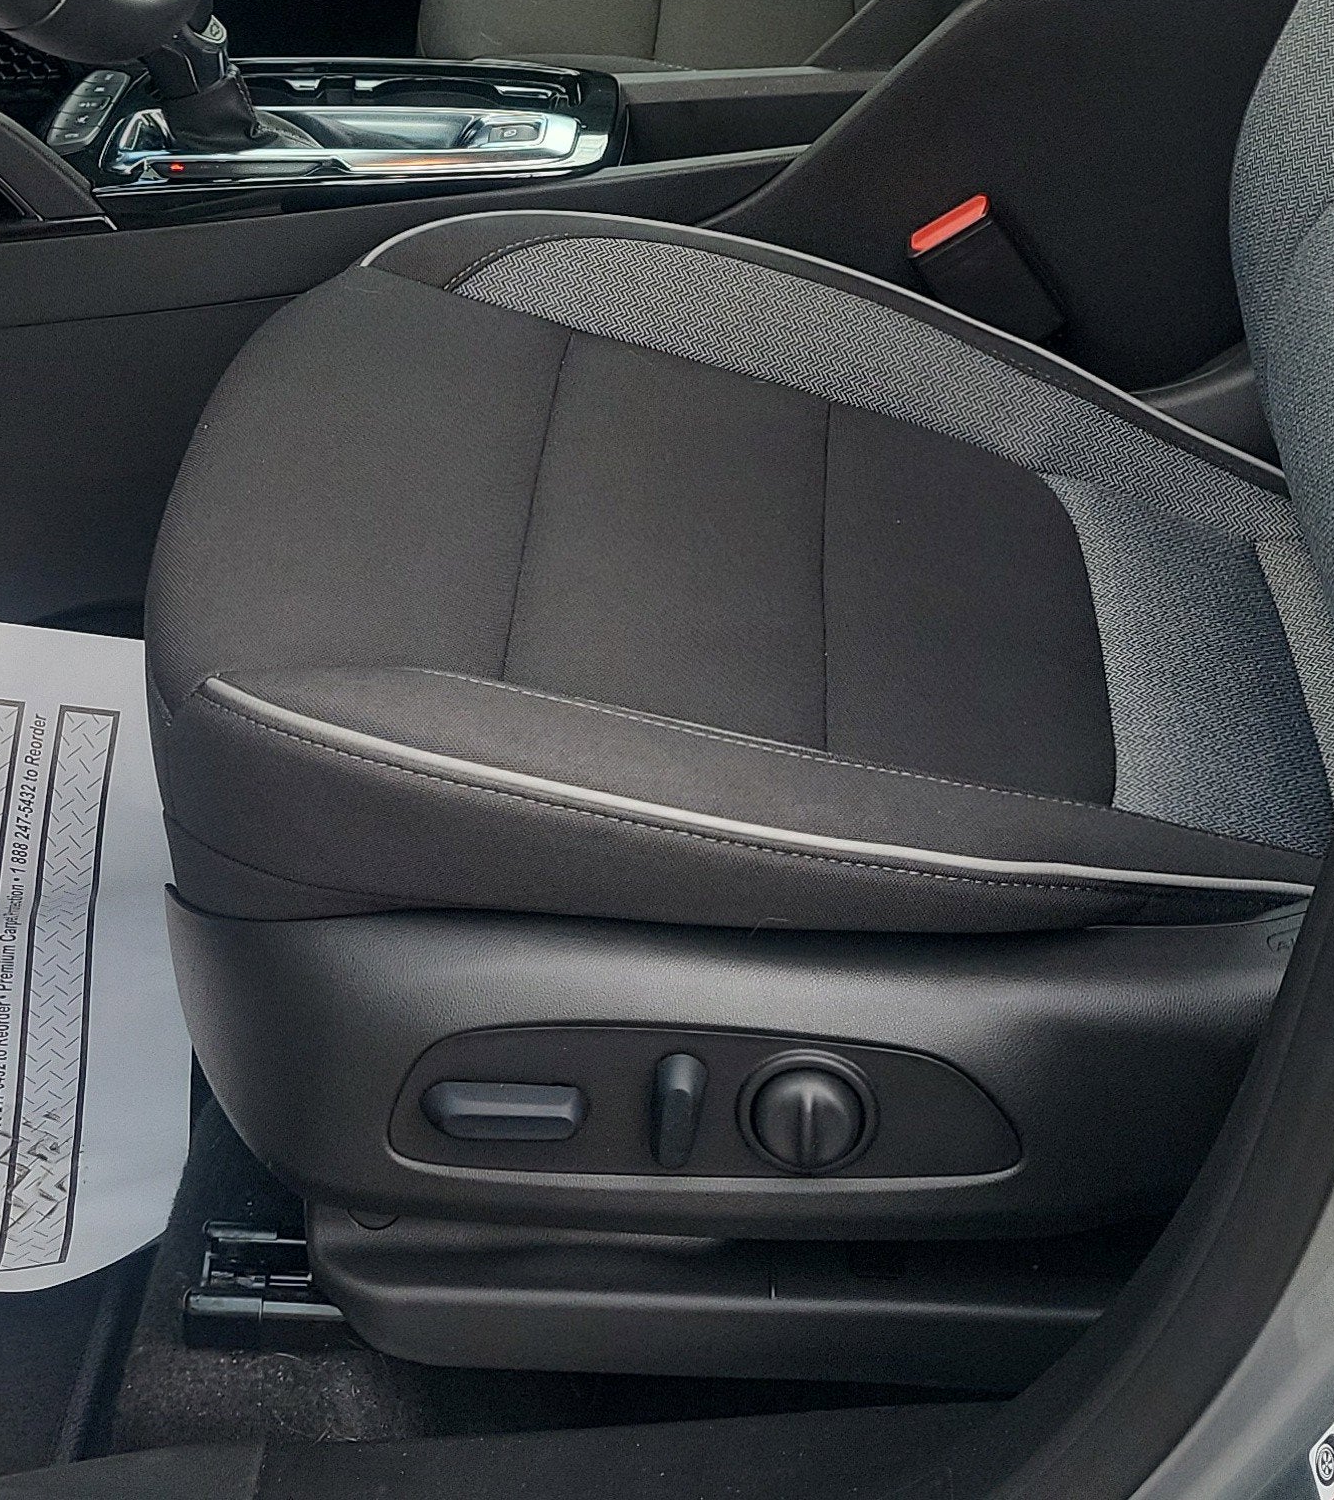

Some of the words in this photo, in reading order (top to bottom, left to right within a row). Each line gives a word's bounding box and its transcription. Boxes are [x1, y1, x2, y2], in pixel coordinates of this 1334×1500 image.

[24, 713, 47, 767] Reorder
[23, 769, 39, 782] to
[15, 784, 36, 841] 247-5432
[11, 842, 28, 865] 888
